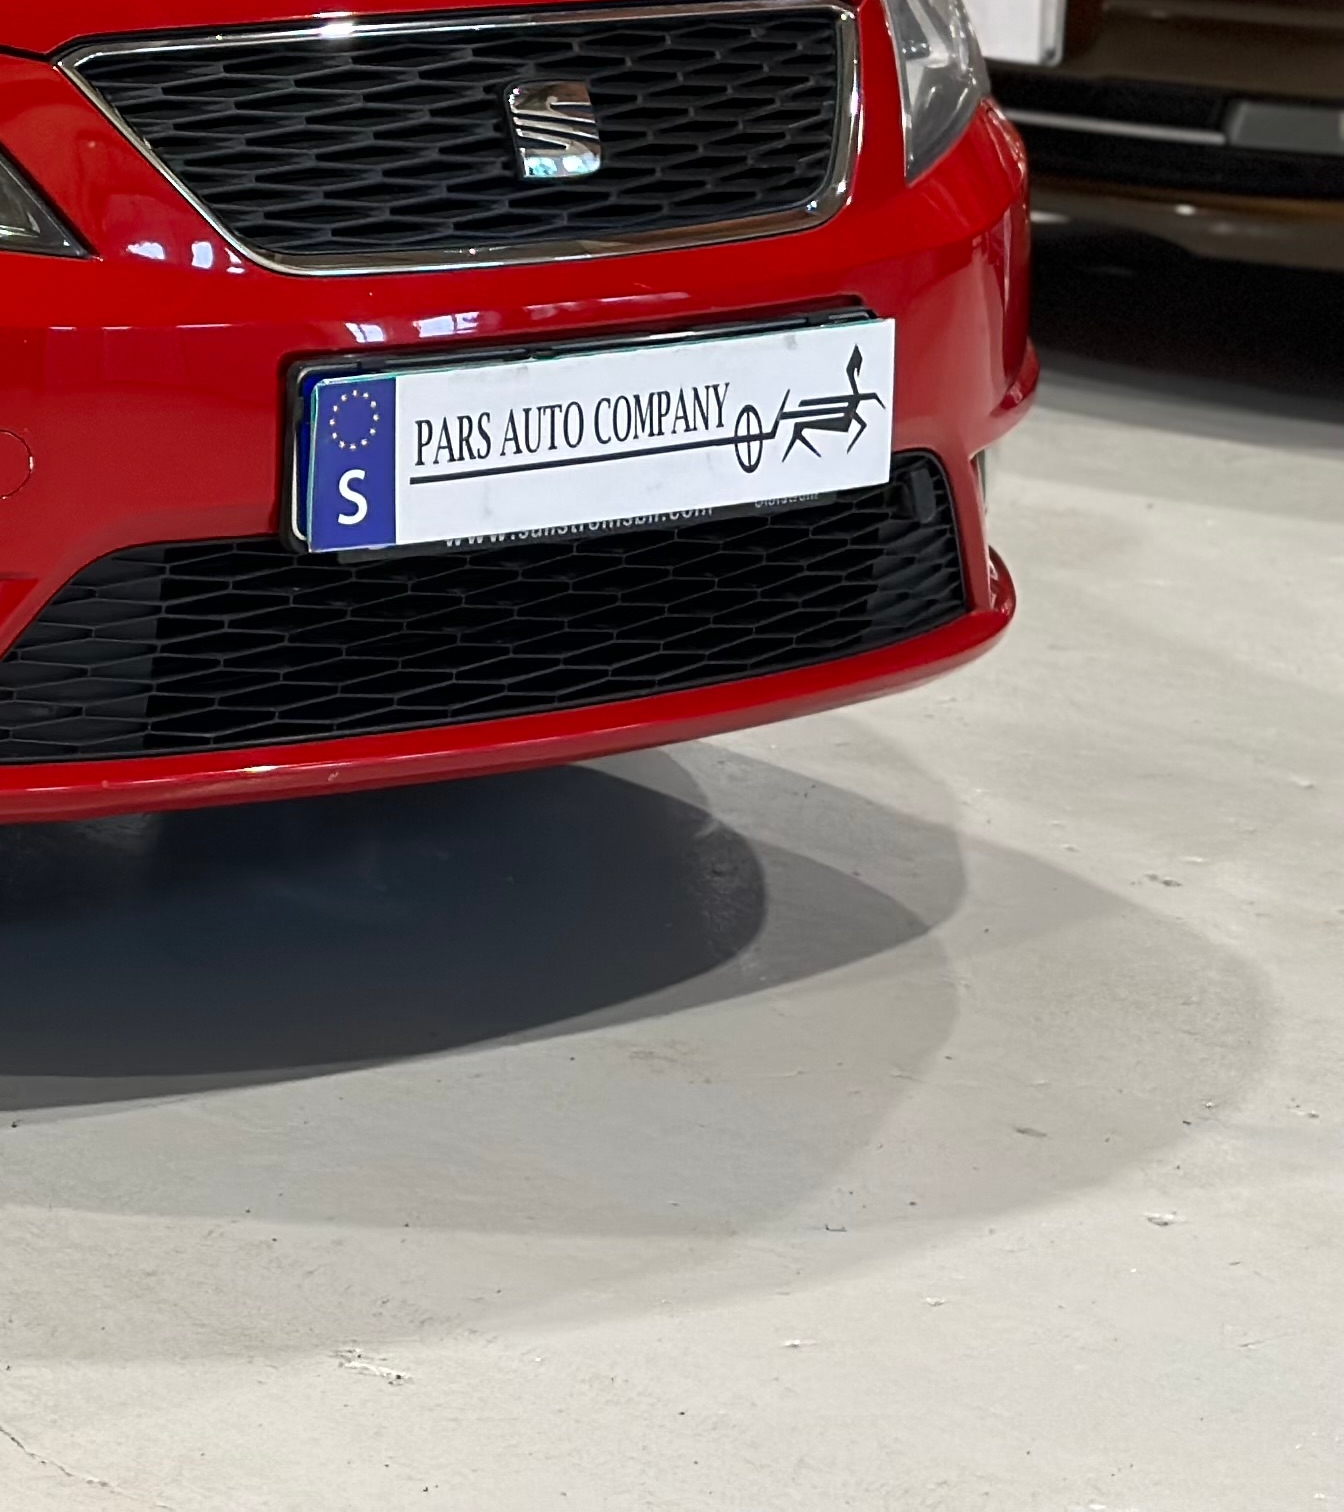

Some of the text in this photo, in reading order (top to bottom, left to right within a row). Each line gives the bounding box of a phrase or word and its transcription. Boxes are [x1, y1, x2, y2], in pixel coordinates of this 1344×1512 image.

[414, 381, 731, 466] PARS AUTO COMPANY
[337, 468, 368, 525] S
